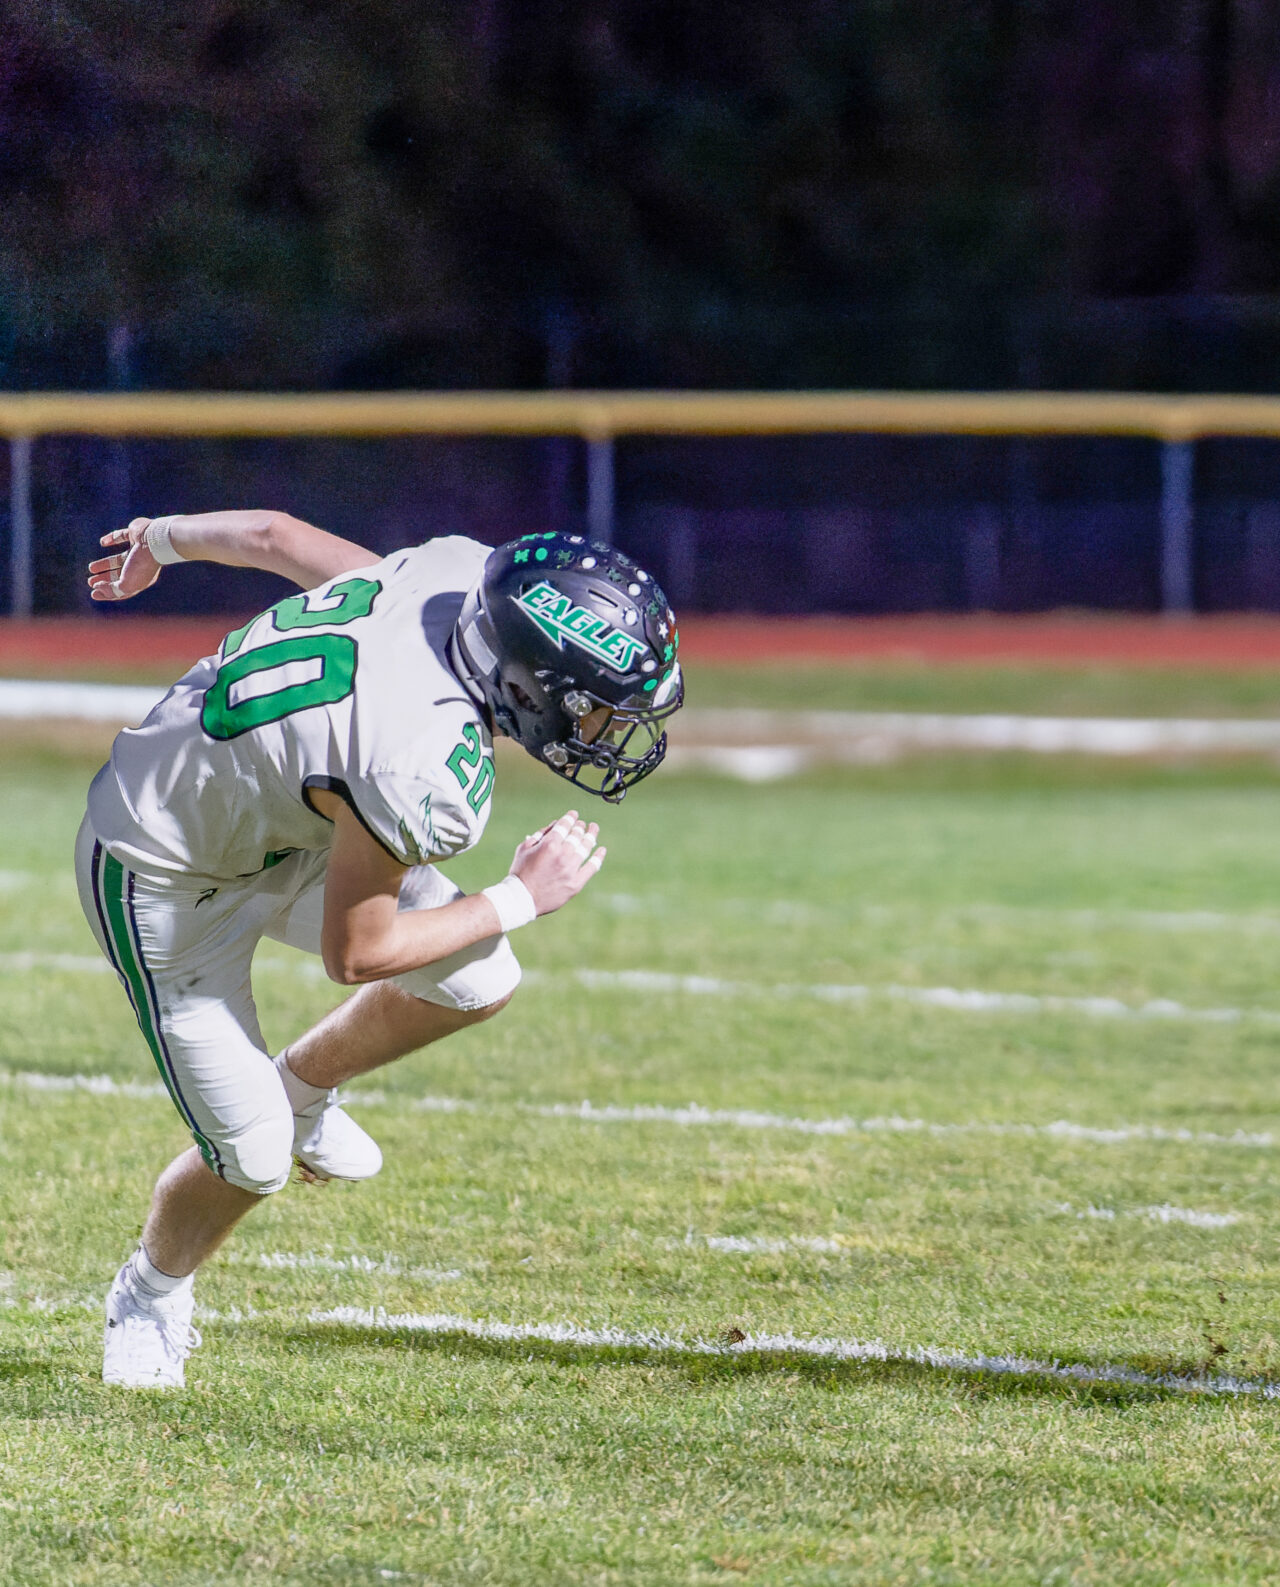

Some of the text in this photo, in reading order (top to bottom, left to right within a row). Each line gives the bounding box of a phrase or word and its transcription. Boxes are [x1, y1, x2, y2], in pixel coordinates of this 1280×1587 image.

[201, 577, 383, 741] 20
[518, 582, 651, 673] EAGLES
[445, 722, 496, 819] 20
